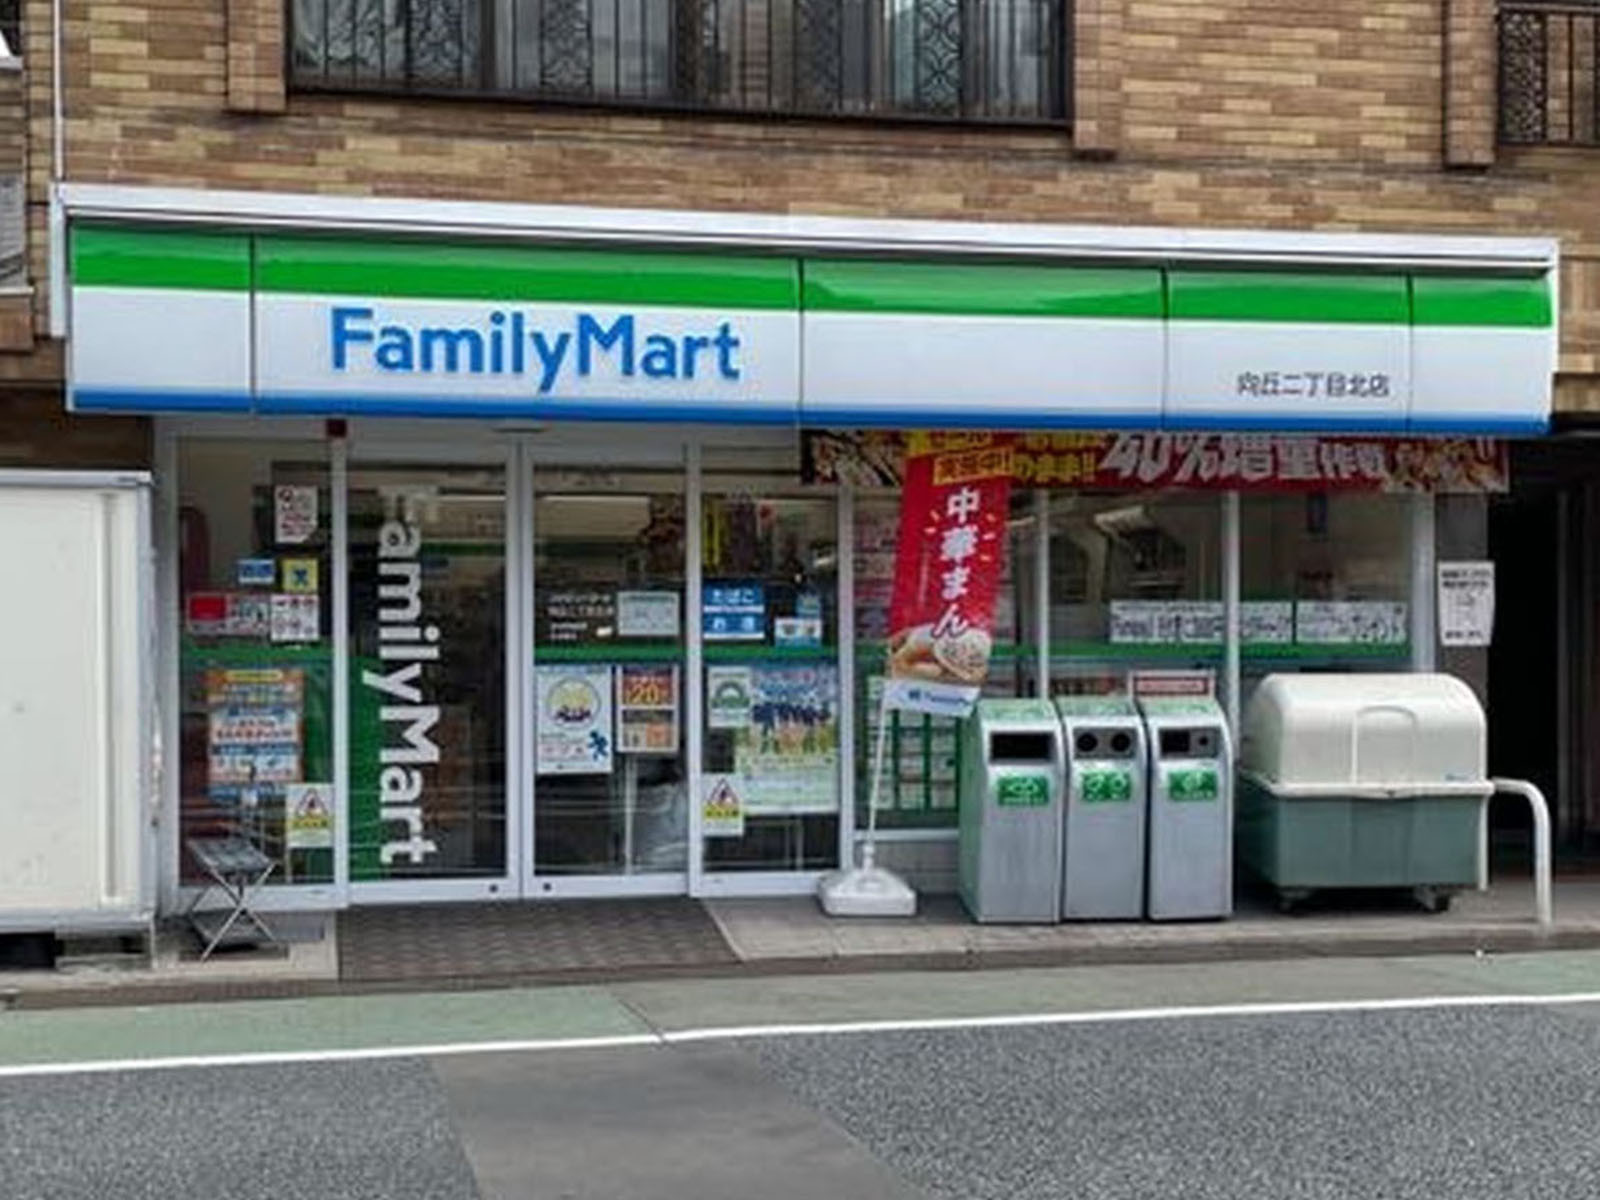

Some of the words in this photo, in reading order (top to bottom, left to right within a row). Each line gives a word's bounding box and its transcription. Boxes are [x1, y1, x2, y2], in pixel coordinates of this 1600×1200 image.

[331, 307, 741, 393] FamilyMart
[1237, 371, 1391, 397] 向丘二丁目北店
[932, 486, 980, 638] 中華まん
